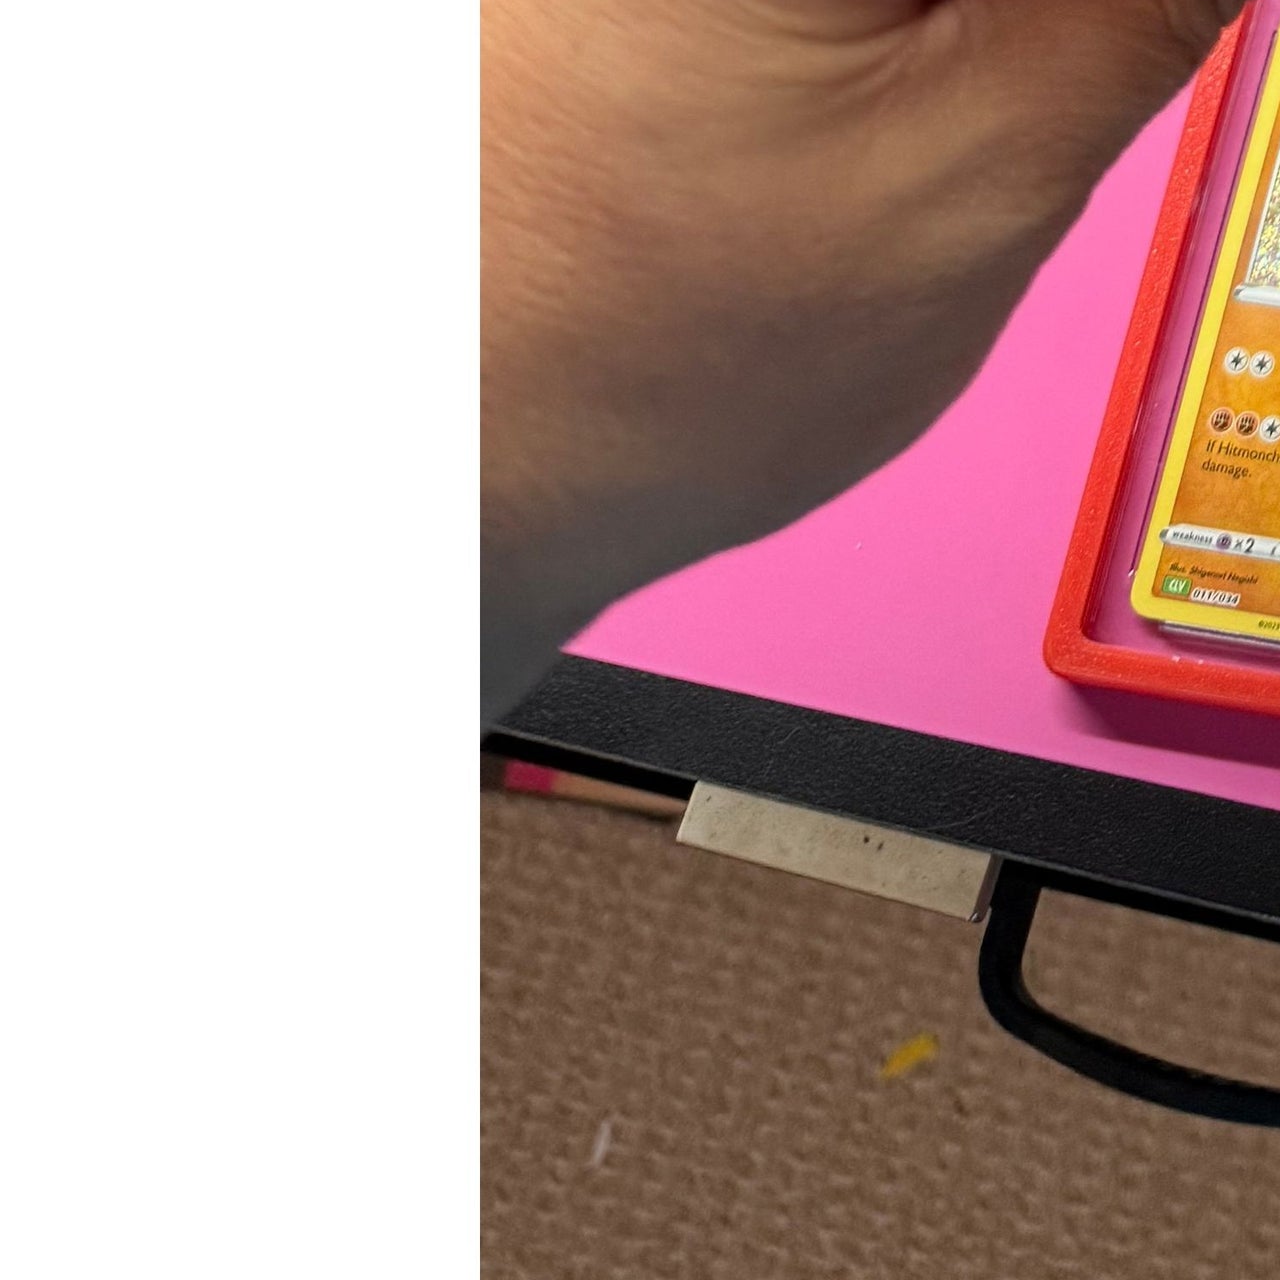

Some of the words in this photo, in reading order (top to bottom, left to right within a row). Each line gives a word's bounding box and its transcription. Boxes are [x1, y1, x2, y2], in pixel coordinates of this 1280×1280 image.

[1206, 439, 1217, 454] If
[1201, 457, 1252, 480] damage.
[1172, 529, 1214, 545] weakness
[1192, 589, 1240, 606] 011/034
